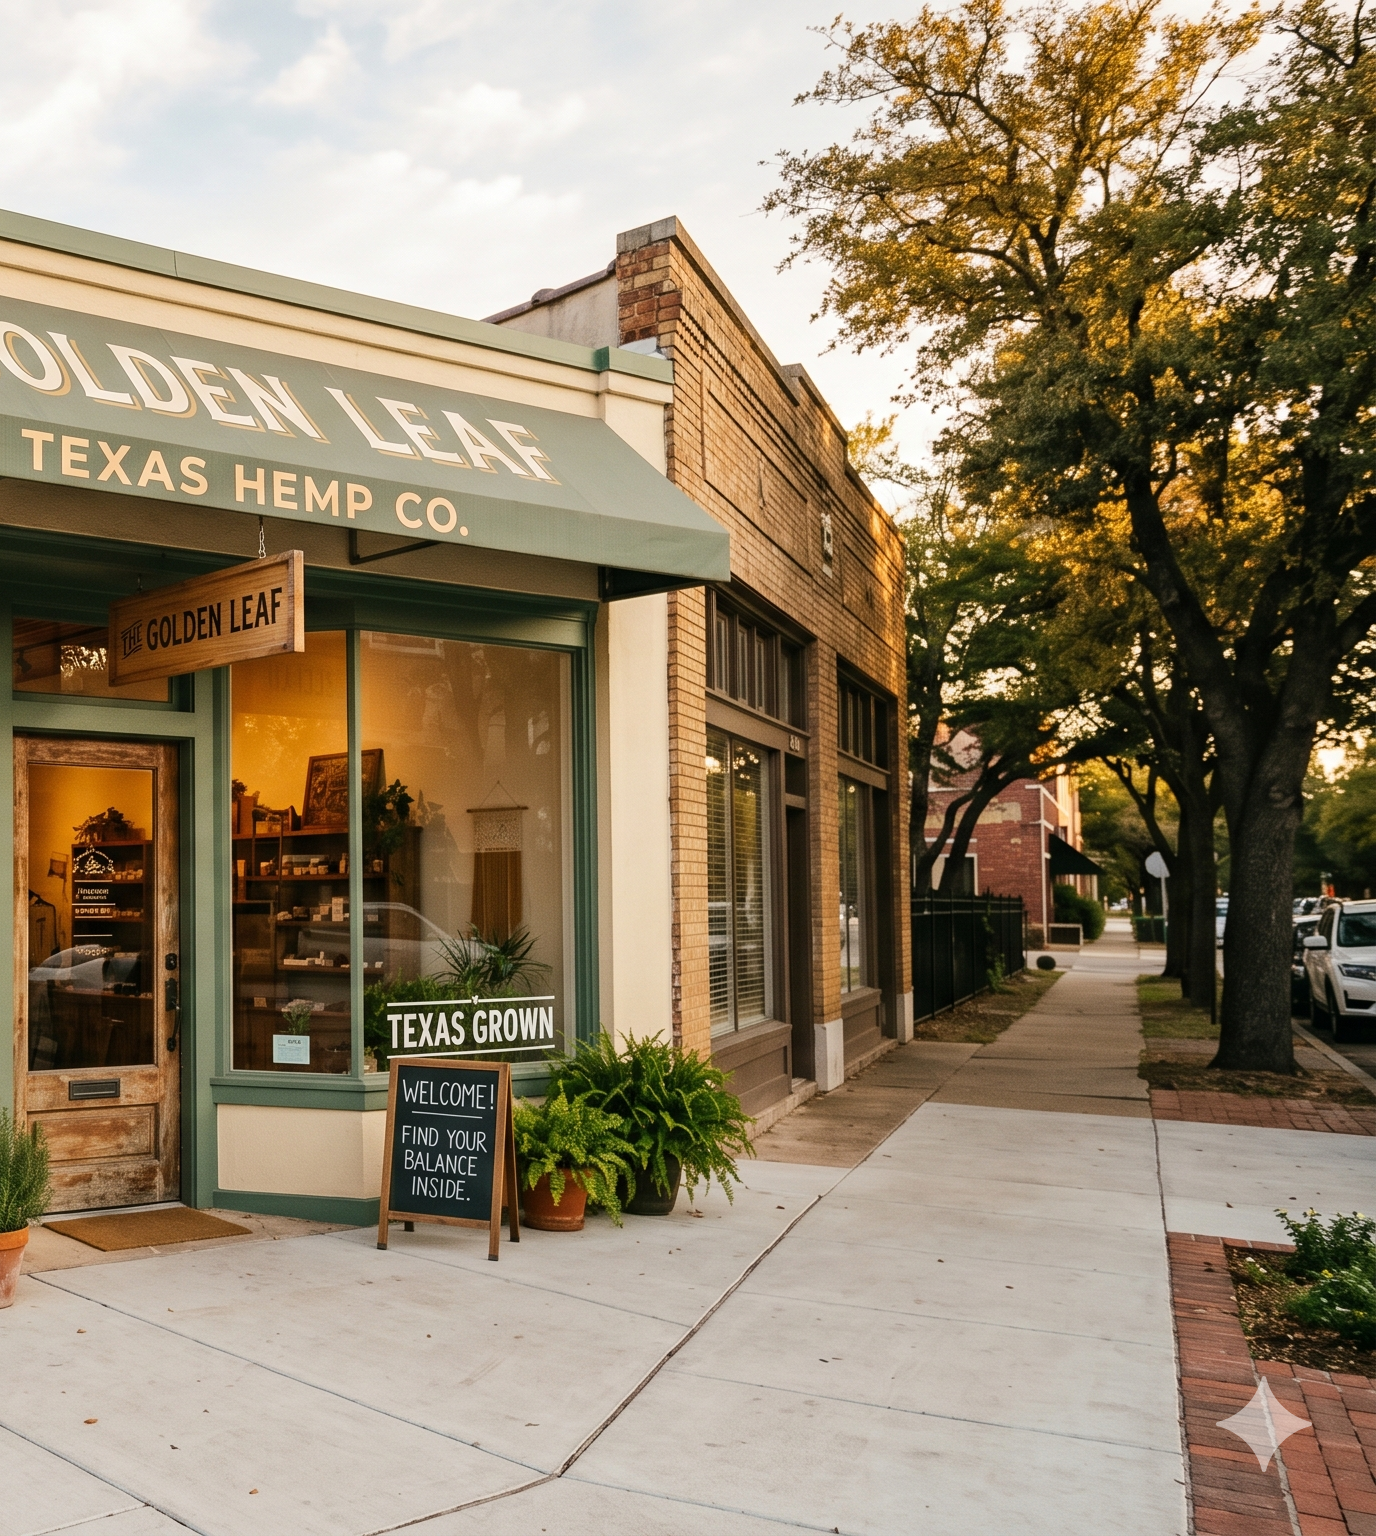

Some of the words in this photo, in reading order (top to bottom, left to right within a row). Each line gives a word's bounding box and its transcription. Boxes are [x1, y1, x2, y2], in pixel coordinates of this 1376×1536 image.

[326, 387, 562, 485] LEAF
[22, 429, 208, 496] TEXAS
[236, 464, 373, 520] HEMP
[395, 492, 470, 537] CO.
[122, 622, 143, 656] THE
[147, 602, 221, 650] GOLDEN
[230, 587, 282, 633] LEAF
[387, 1011, 465, 1049] TEXAS
[472, 1006, 554, 1044] GROWN
[402, 1079, 495, 1110] WELCOME!
[401, 1125, 439, 1147] FIND
[446, 1129, 488, 1153] YOUR
[404, 1149, 478, 1177] BALANCE
[411, 1176, 471, 1202] INSIDE.
